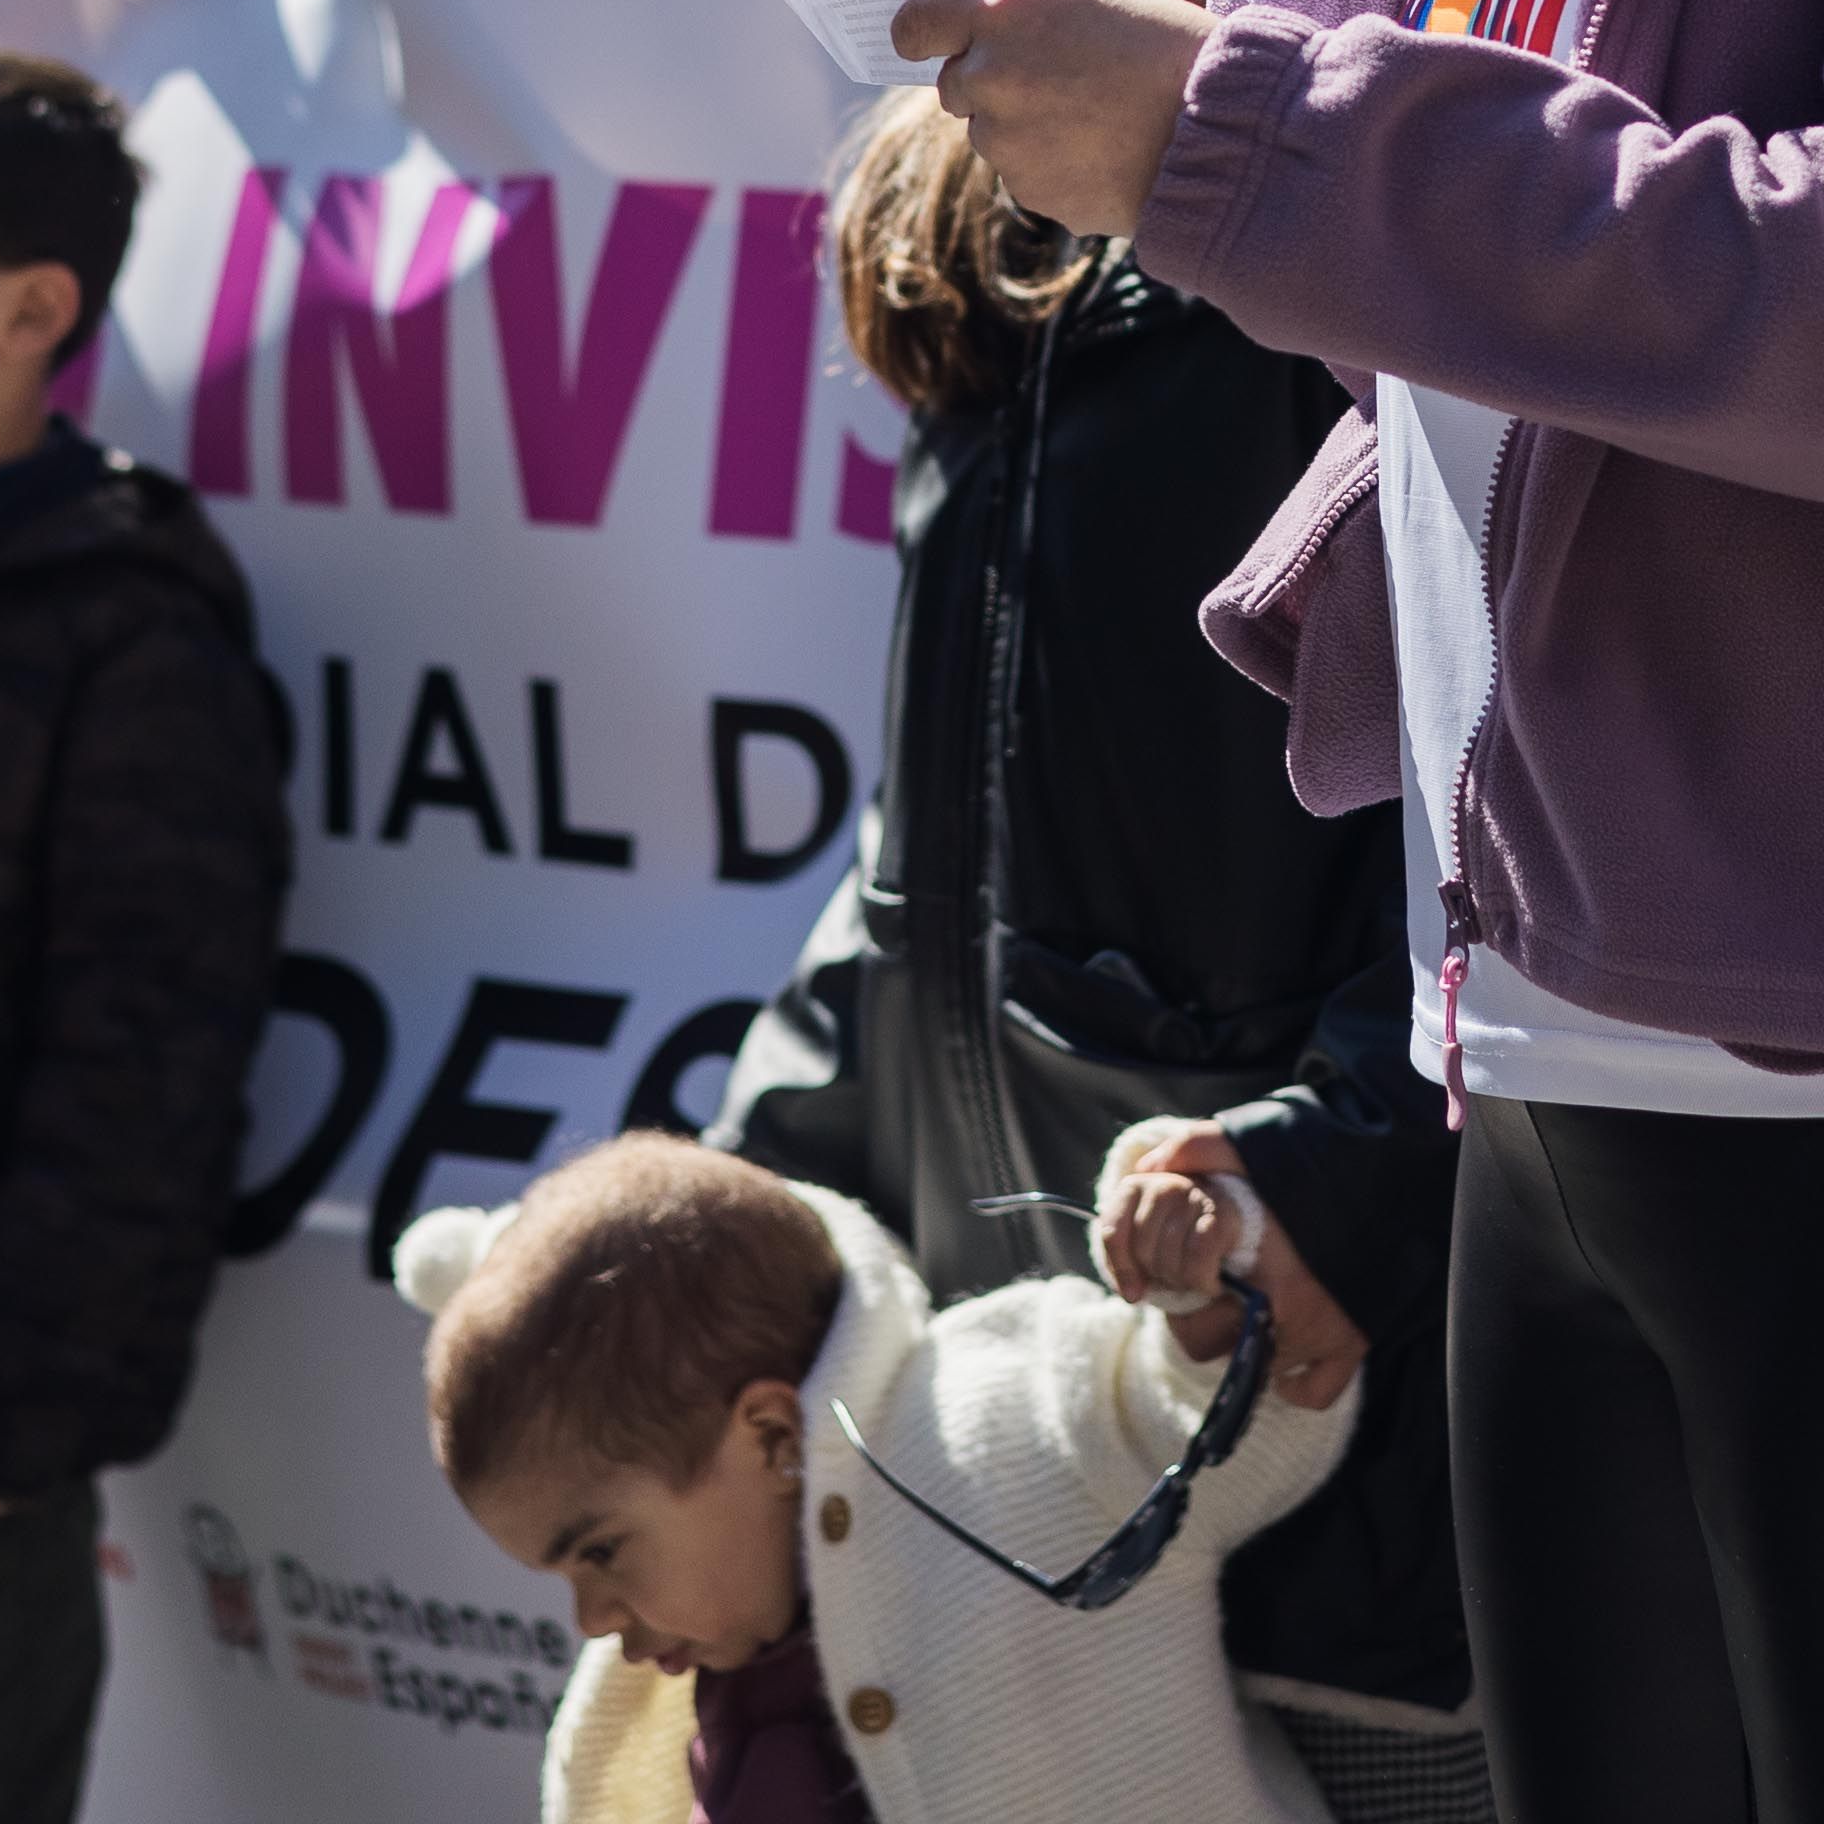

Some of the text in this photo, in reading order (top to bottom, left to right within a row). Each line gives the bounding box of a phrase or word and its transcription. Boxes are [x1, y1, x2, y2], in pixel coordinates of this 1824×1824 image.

[276, 654, 638, 872] IAL
[272, 1550, 572, 1670] Duchenne
[372, 1644, 560, 1738] Españ
